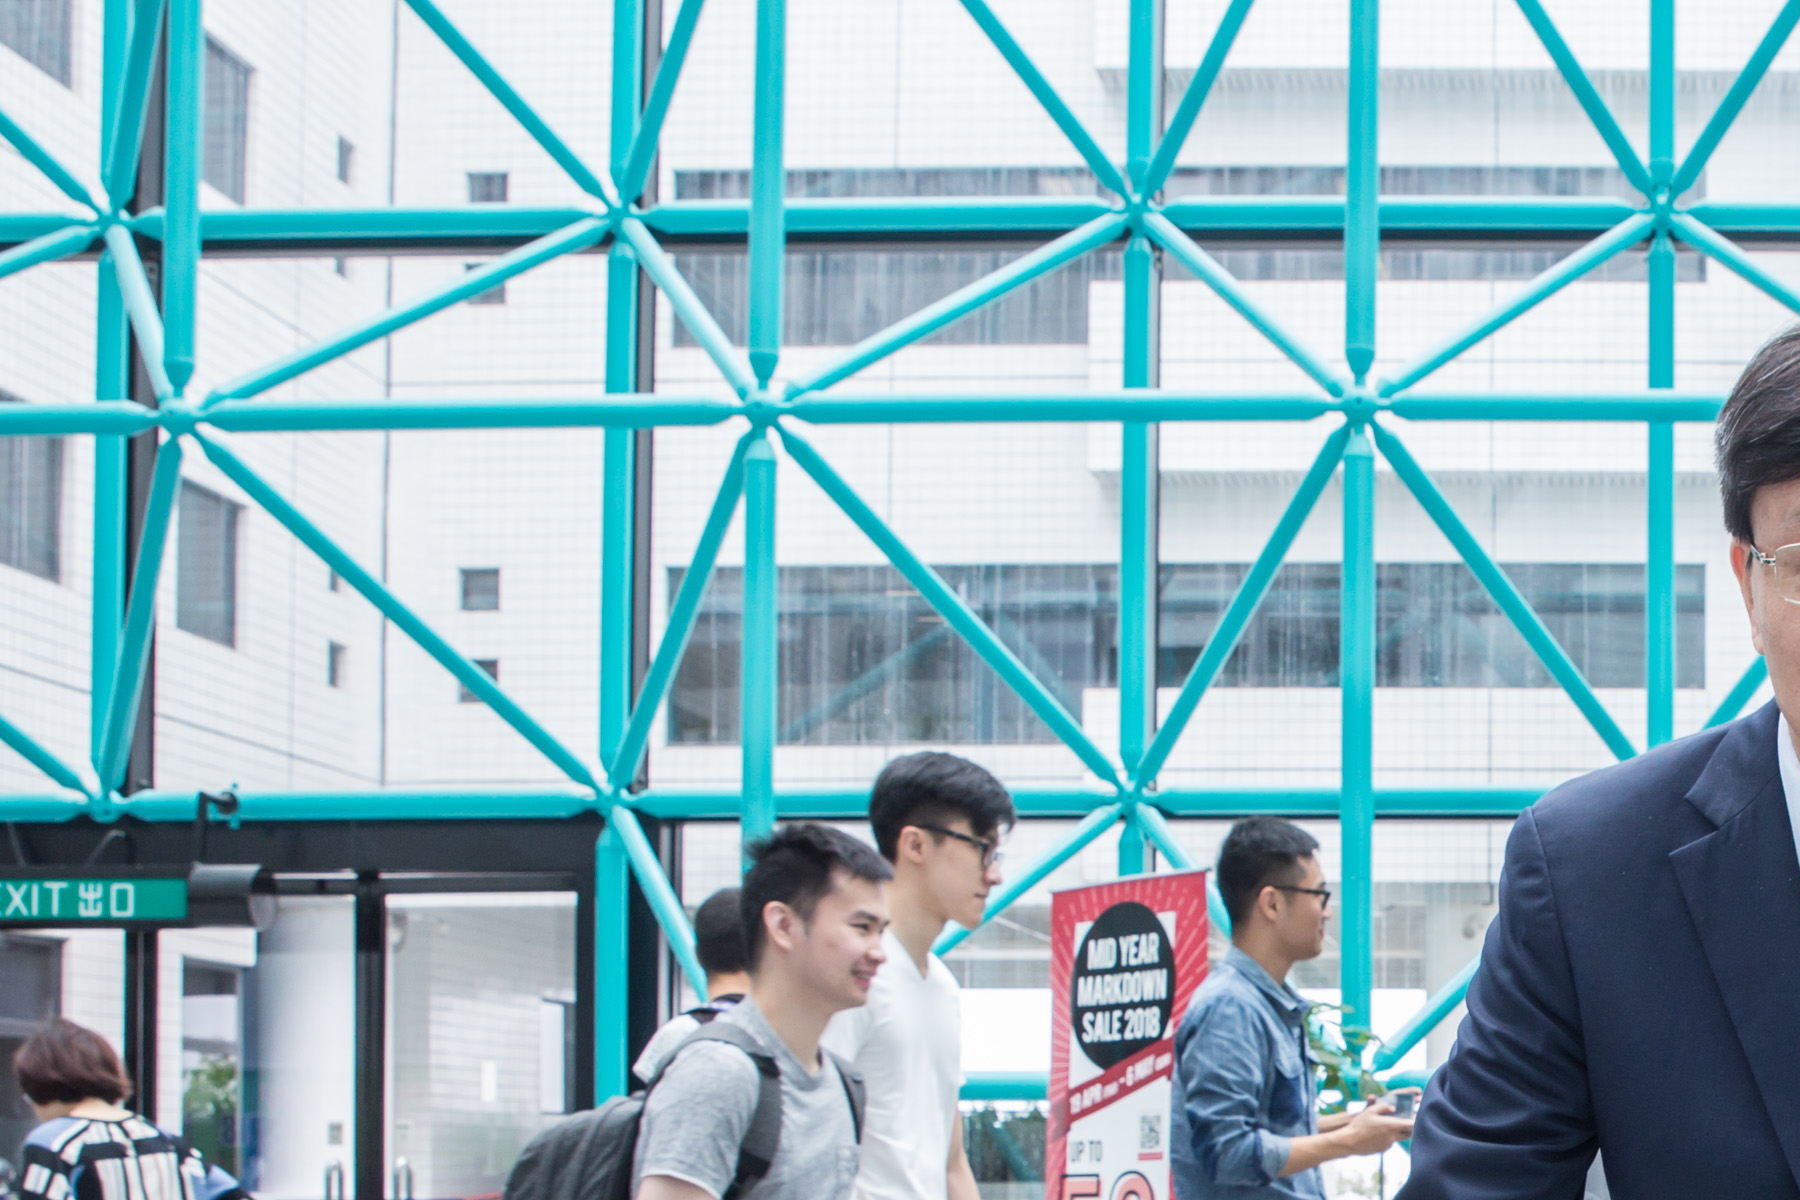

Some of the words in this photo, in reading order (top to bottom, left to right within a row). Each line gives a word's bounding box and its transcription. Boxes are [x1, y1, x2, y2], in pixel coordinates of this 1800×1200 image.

[0, 881, 69, 917] XIT
[78, 881, 135, 918] 出口
[1087, 937, 1117, 970] MID
[1119, 932, 1159, 967] YEAR
[1077, 968, 1168, 1008] MARKDOWN
[1081, 1009, 1122, 1044] SALE
[1123, 1006, 1161, 1041] 2018
[1070, 1140, 1085, 1162] UP
[1088, 1140, 1103, 1162] TO
